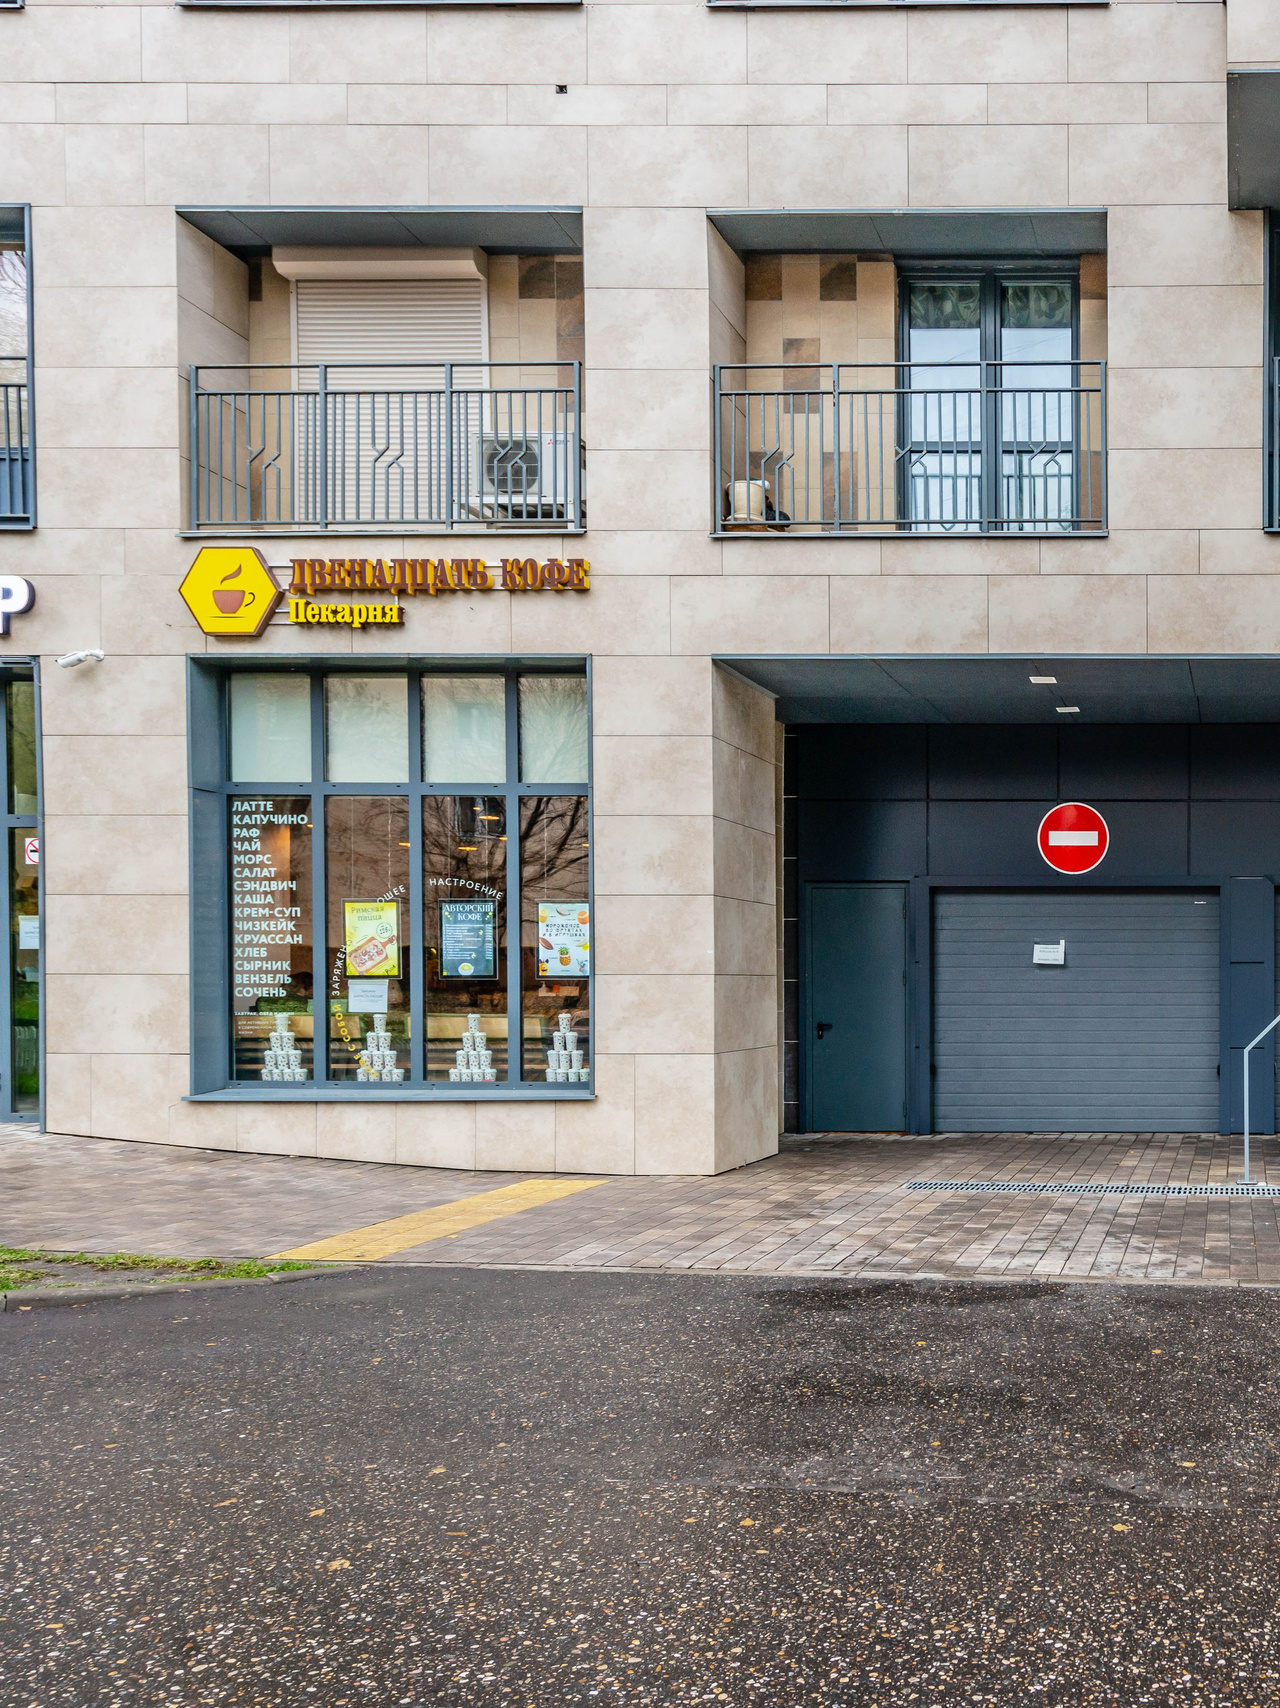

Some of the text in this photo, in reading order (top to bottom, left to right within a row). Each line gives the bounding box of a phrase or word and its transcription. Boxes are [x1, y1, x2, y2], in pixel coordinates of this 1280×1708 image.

[289, 558, 588, 594] ДВЕНАДЦАТЬ КОФЕ
[288, 599, 401, 628] Пекарня
[232, 801, 273, 812] ЛАТТЕ
[233, 814, 308, 825] КАПУЧИНО
[233, 828, 260, 838] РАФ
[233, 839, 261, 851] ЧАЙ
[233, 854, 272, 865] МОРС
[233, 867, 277, 878] САЛАТ
[233, 881, 297, 892] СЭНДВИЧ
[429, 878, 503, 900] НАСТРОЕНИЕ
[234, 894, 274, 904] КАША
[234, 907, 301, 918] КРЕМ-СУП
[444, 903, 493, 912] АВТОРСКИЙ
[457, 913, 482, 921] КОФЕ
[234, 919, 296, 931] ЧИЗКЕЙК
[234, 934, 303, 944] КРУАССАН
[234, 947, 267, 957] ХЛЕБ
[234, 961, 291, 971] СЫРНИК
[235, 974, 292, 984] ВЕНЗЕЛЬ
[234, 987, 287, 997] СОЧЕНЬ
